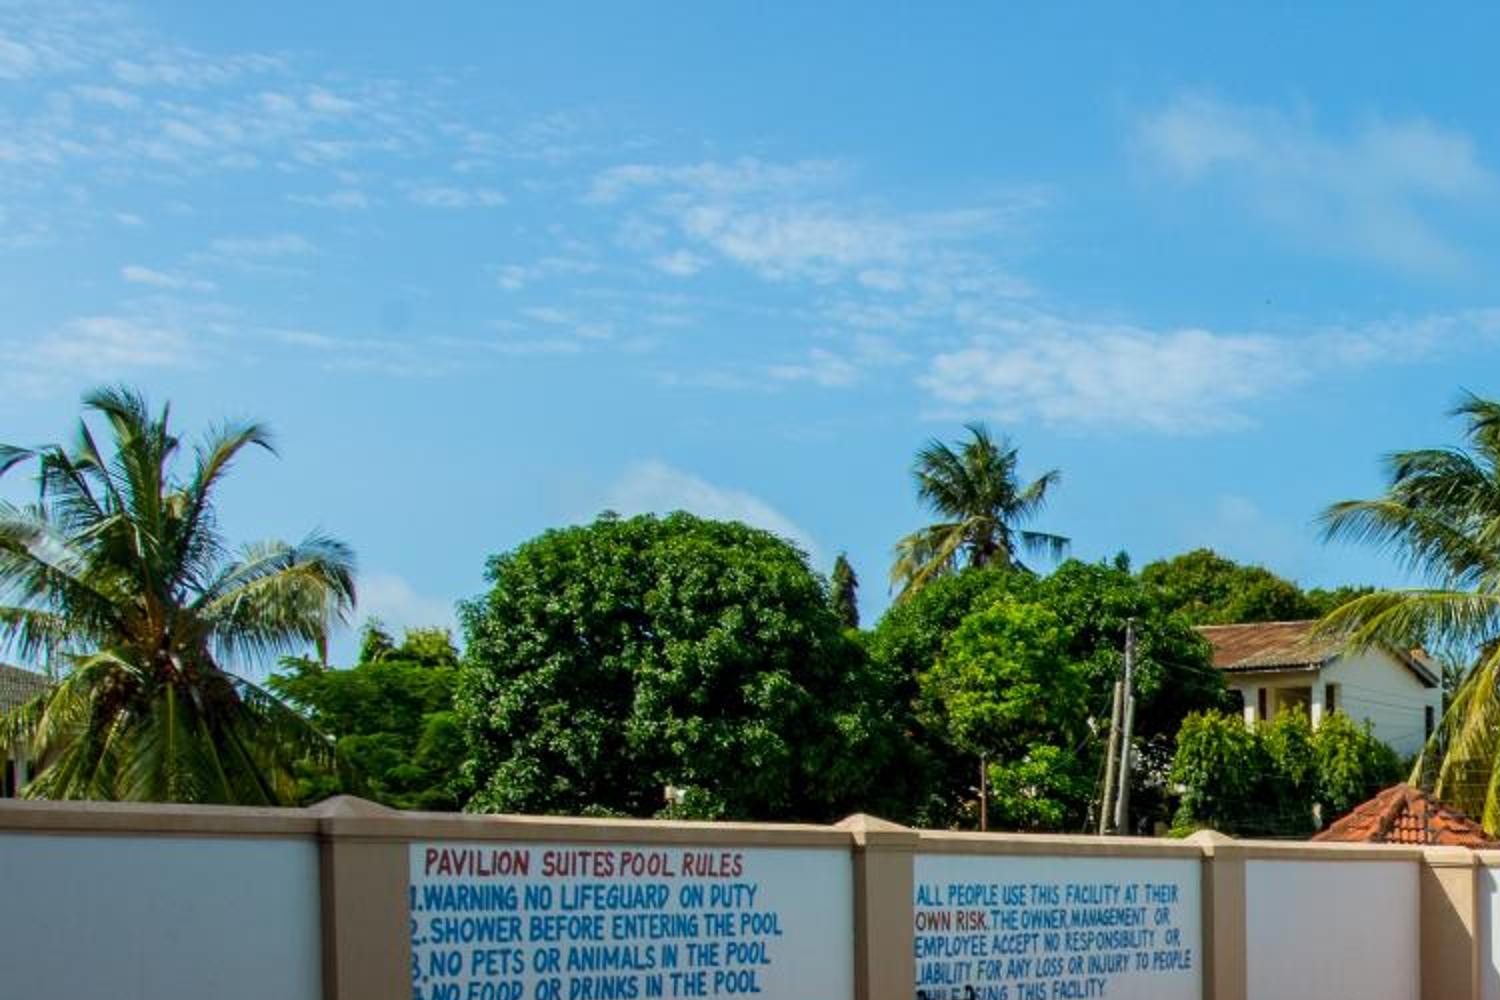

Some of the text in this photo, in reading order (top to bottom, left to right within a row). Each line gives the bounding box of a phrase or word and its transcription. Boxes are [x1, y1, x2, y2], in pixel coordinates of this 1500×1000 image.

[425, 848, 743, 877] PAVILION SUITES POOL RULES
[524, 884, 551, 911] NO
[560, 883, 669, 911] LIFEGUARD
[680, 884, 704, 908] ON
[711, 883, 757, 908] DUTY
[917, 883, 1178, 906] ALL PEOPLE USE THIS FACILITY AT THEIR
[529, 915, 604, 942] BEFORE
[612, 912, 698, 940] ENTERING
[704, 913, 735, 937] THE
[741, 912, 782, 936] POOL
[915, 911, 951, 931] OWN
[990, 909, 1019, 930] THE
[1071, 907, 1147, 928] MANAGEMENT
[1154, 907, 1171, 926] OR
[914, 927, 1181, 959] EMPLOYEE ACCEPT NO RESPONSIBILITY OR
[472, 949, 525, 977] PETS
[533, 947, 561, 973] OR
[566, 945, 656, 971] ANIMALS
[661, 944, 678, 968] IN
[686, 943, 719, 967] THE
[726, 941, 771, 965] POOL
[977, 959, 1002, 981] FOR
[1006, 957, 1032, 979] ANY
[1035, 956, 1064, 979] LOSS
[1067, 955, 1084, 975] OR
[1087, 953, 1130, 975] INJURY
[1135, 951, 1149, 971] TO
[1152, 948, 1192, 971] PEOPLE
[646, 973, 662, 998] IN
[669, 971, 707, 998] THE
[714, 970, 761, 994] POOL
